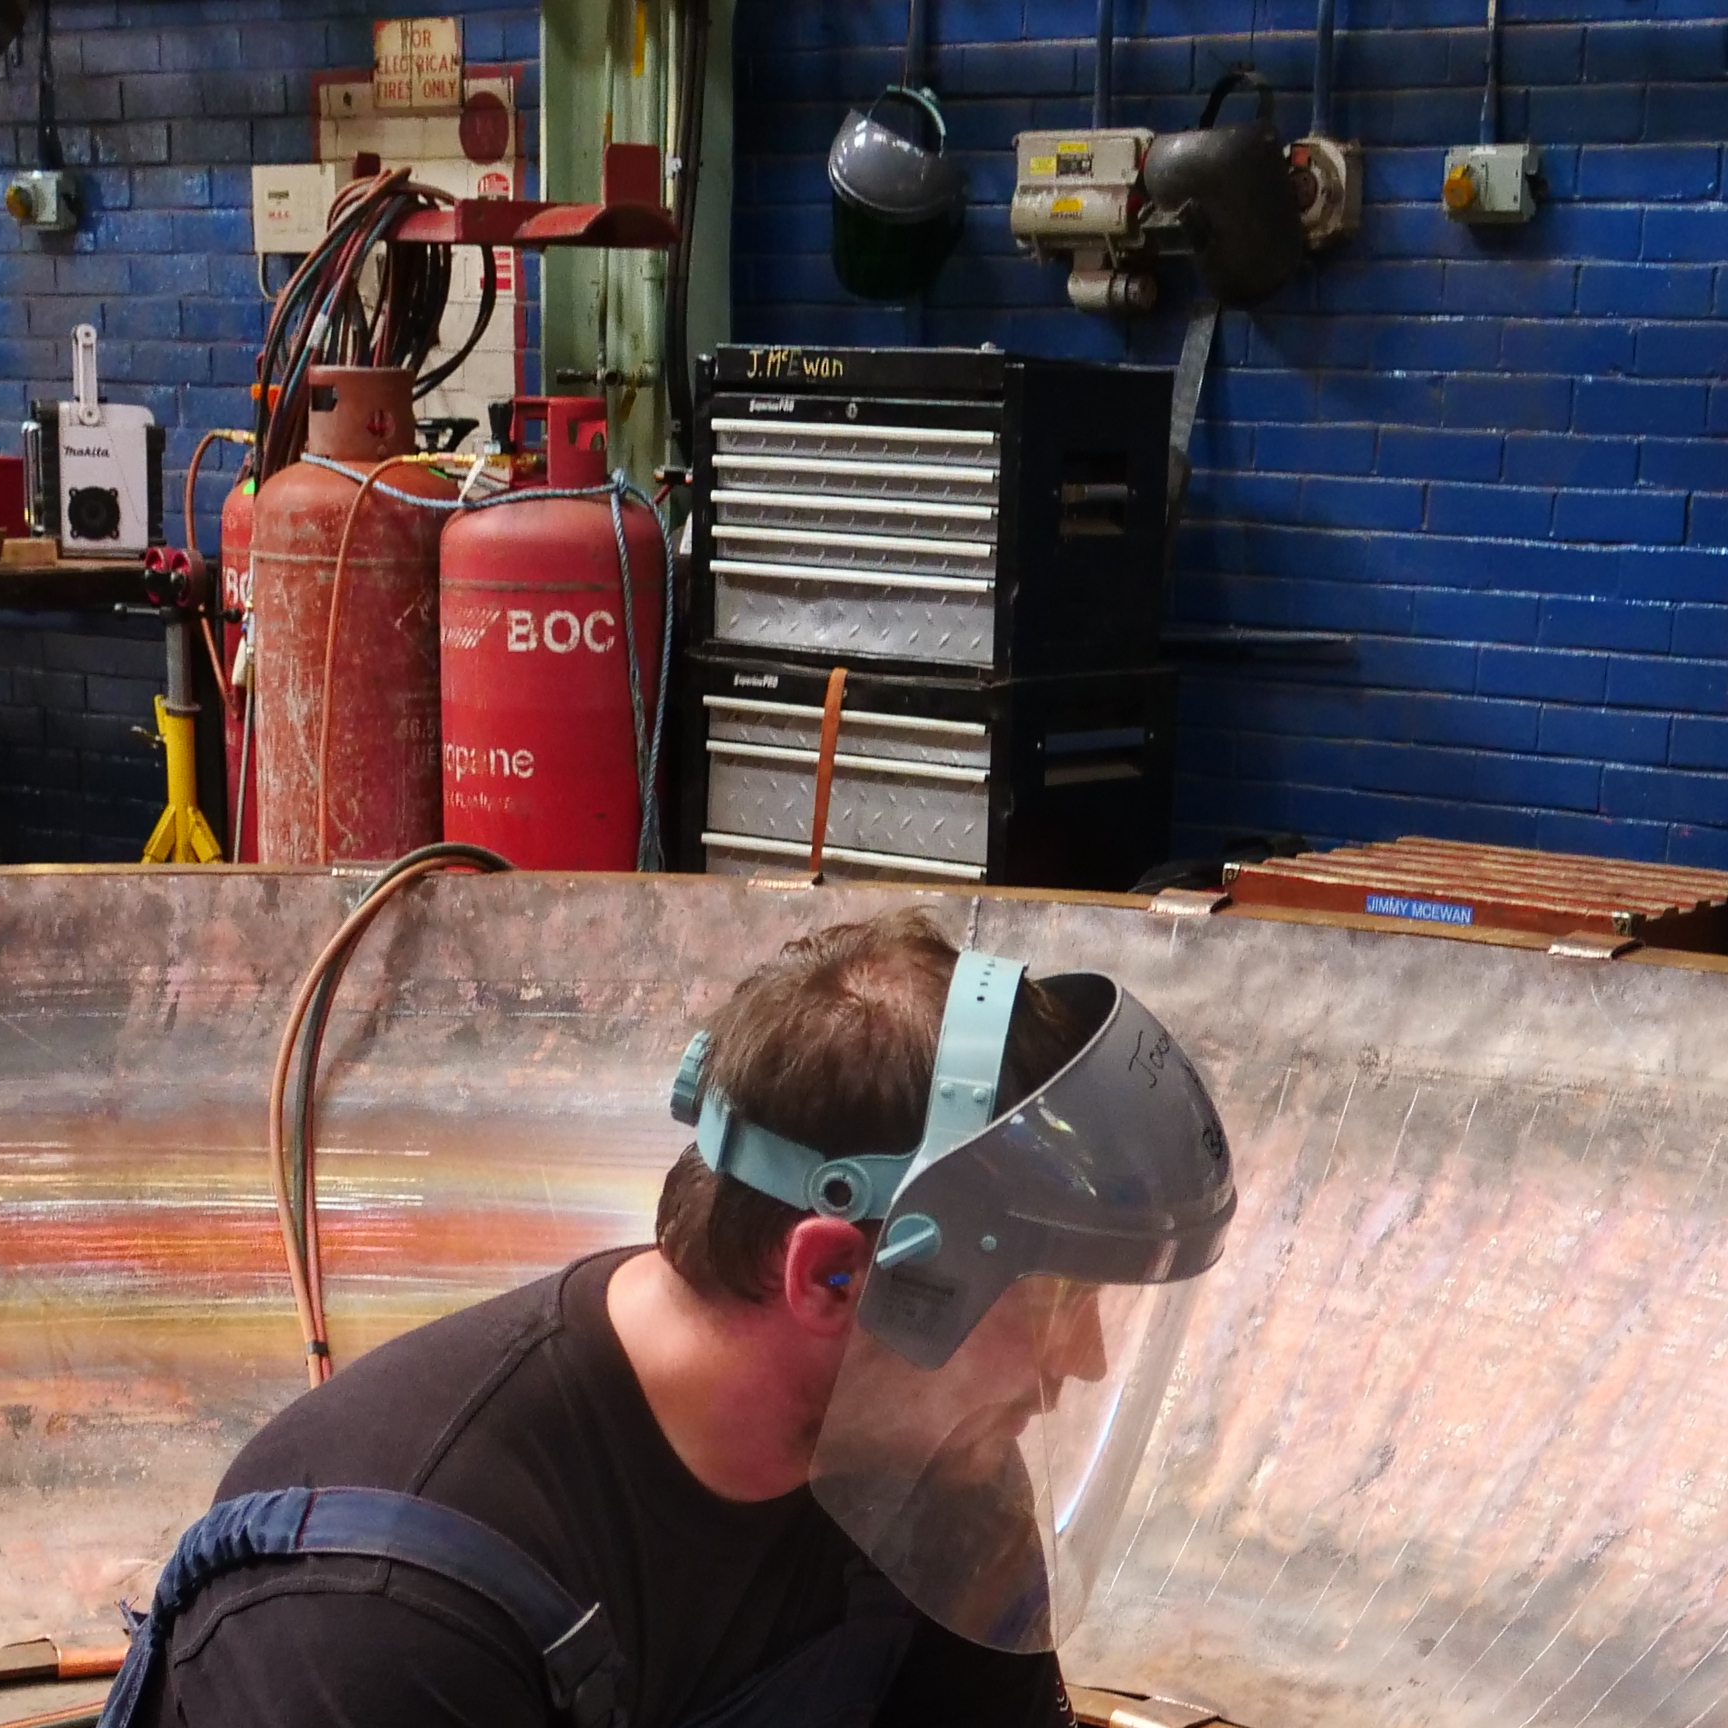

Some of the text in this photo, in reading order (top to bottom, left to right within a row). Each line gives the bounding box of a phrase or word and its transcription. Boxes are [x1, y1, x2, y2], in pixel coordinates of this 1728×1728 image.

[423, 79, 456, 98] ONLY
[507, 609, 615, 654] BOC
[1368, 898, 1472, 923] JIMMY MCEWAN
